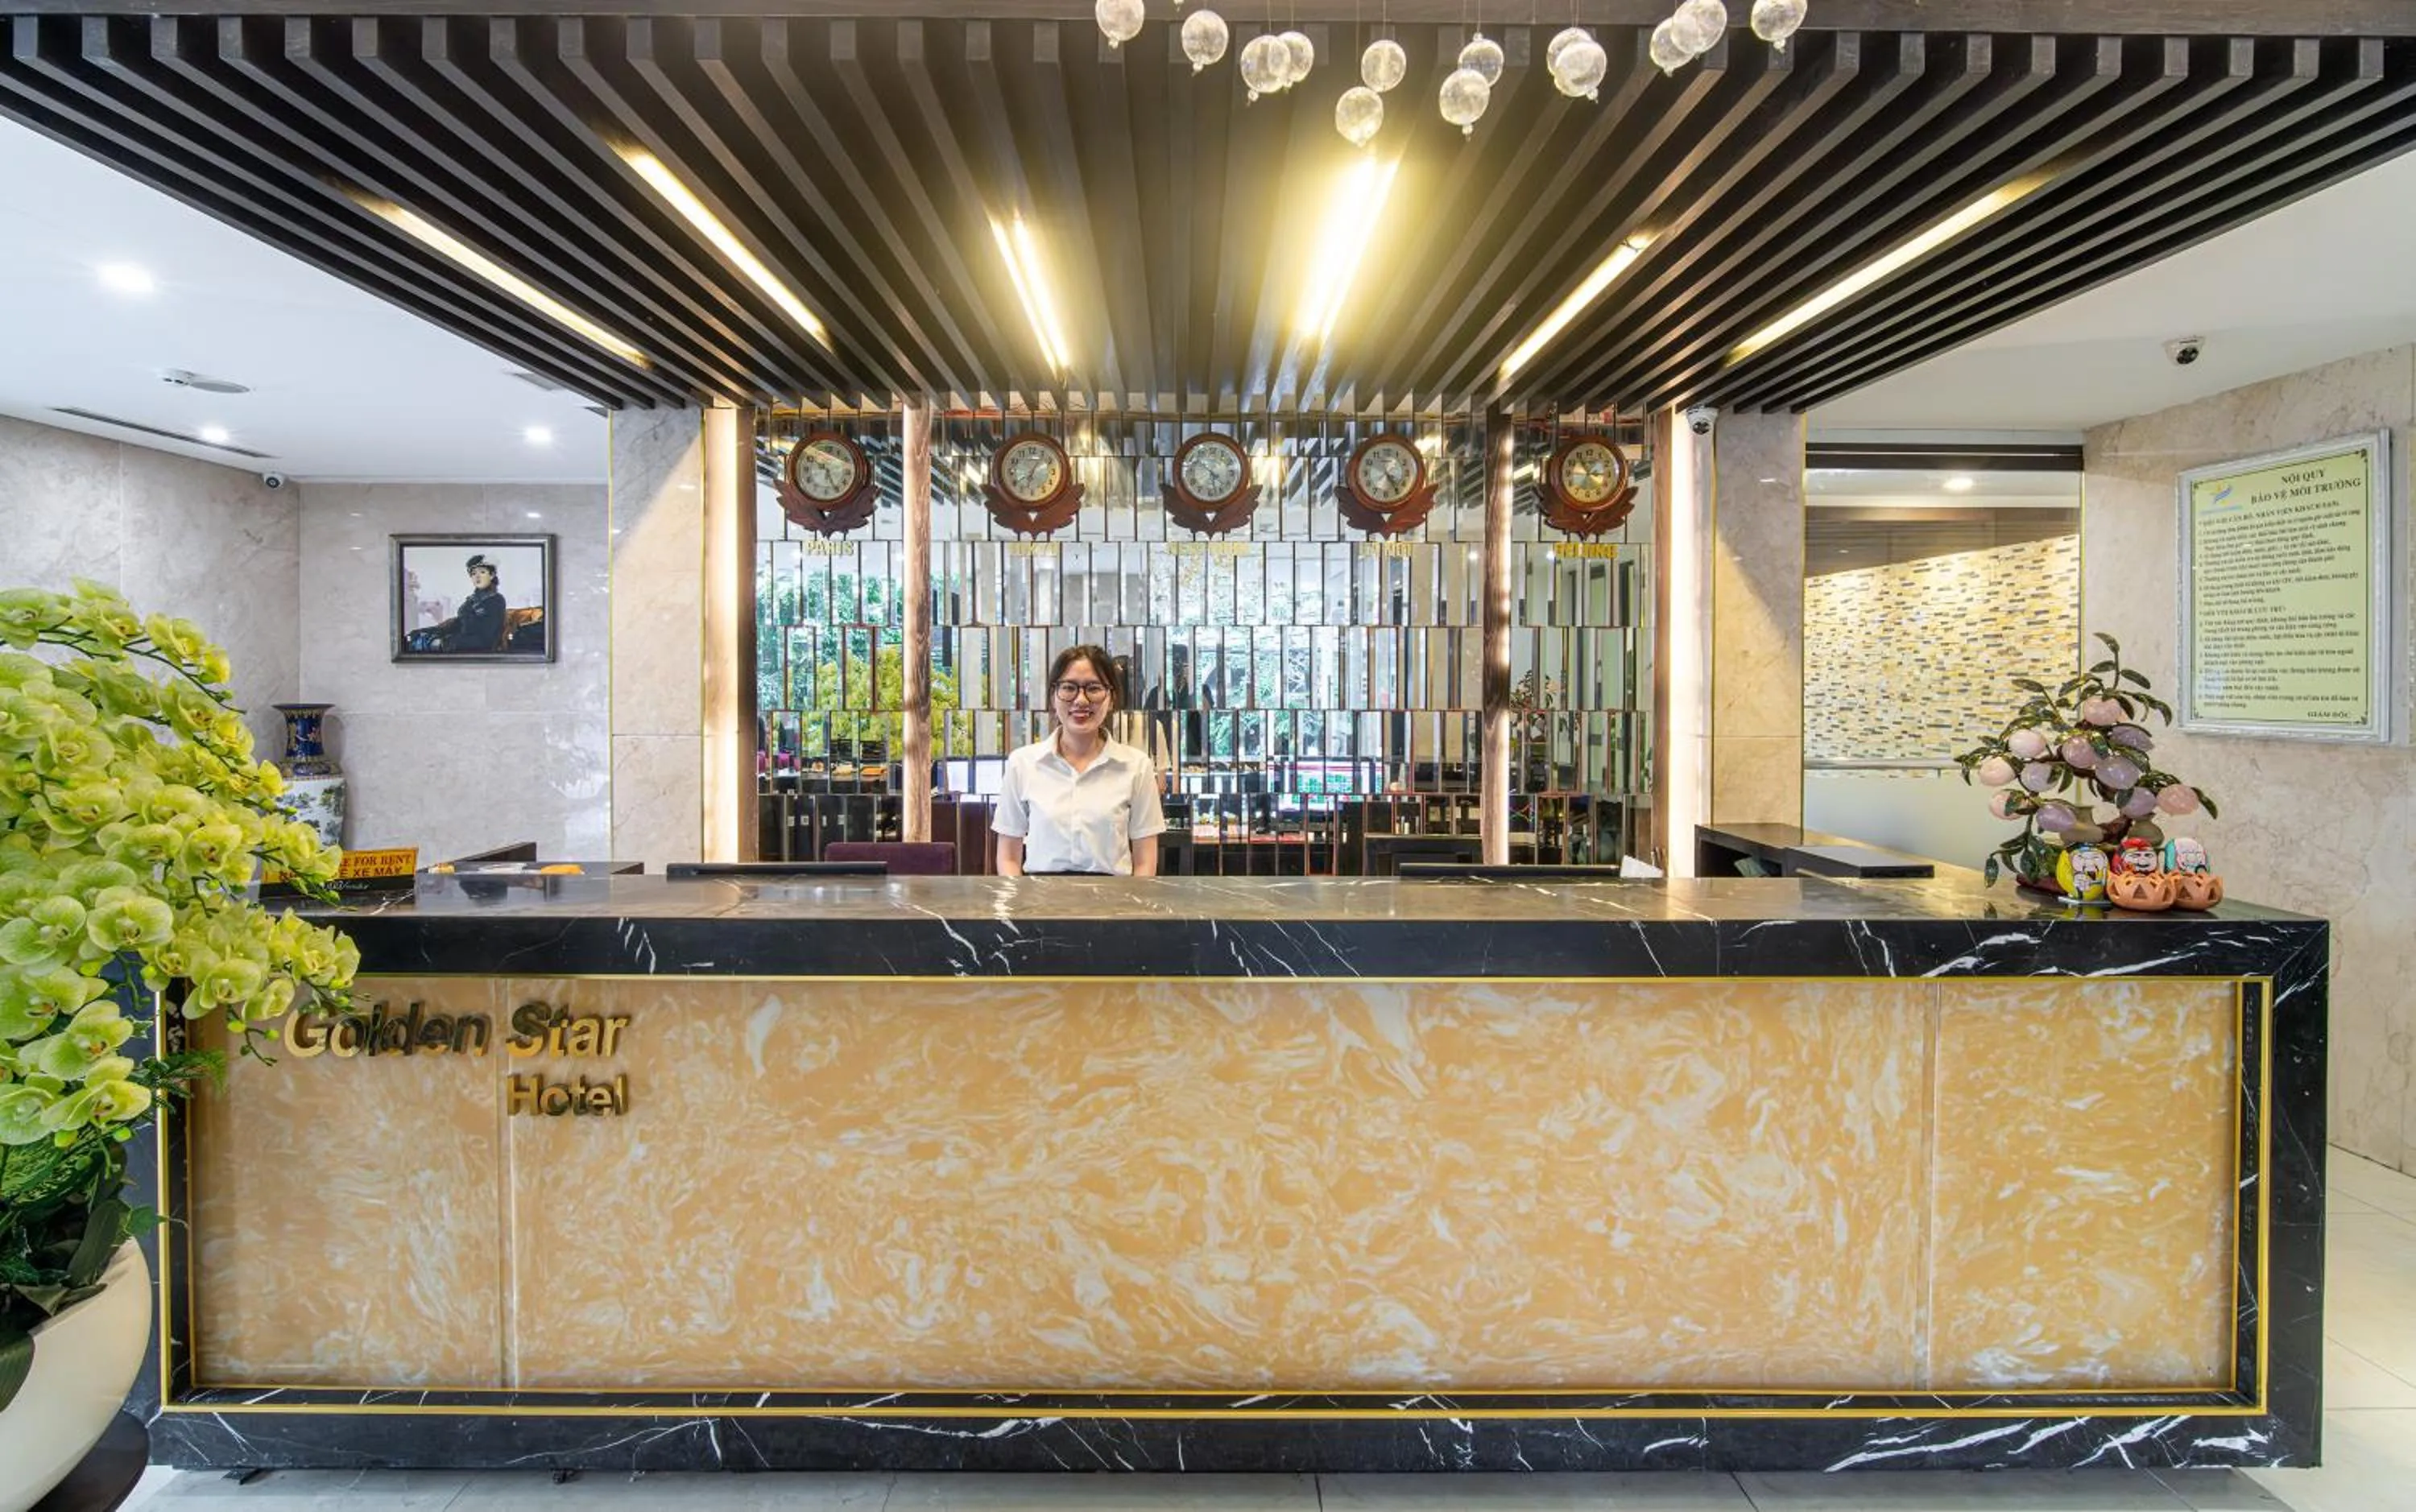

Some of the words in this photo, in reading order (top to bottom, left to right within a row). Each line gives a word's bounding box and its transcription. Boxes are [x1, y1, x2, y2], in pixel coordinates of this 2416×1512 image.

[2303, 469, 2325, 482] QUY
[805, 539, 854, 556] PARIS
[354, 856, 376, 867] FOR
[380, 853, 412, 865] RENT
[354, 868, 370, 878] XE
[284, 1001, 491, 1057] Golden
[506, 1001, 630, 1057] Star
[507, 1074, 628, 1116] Hotel
